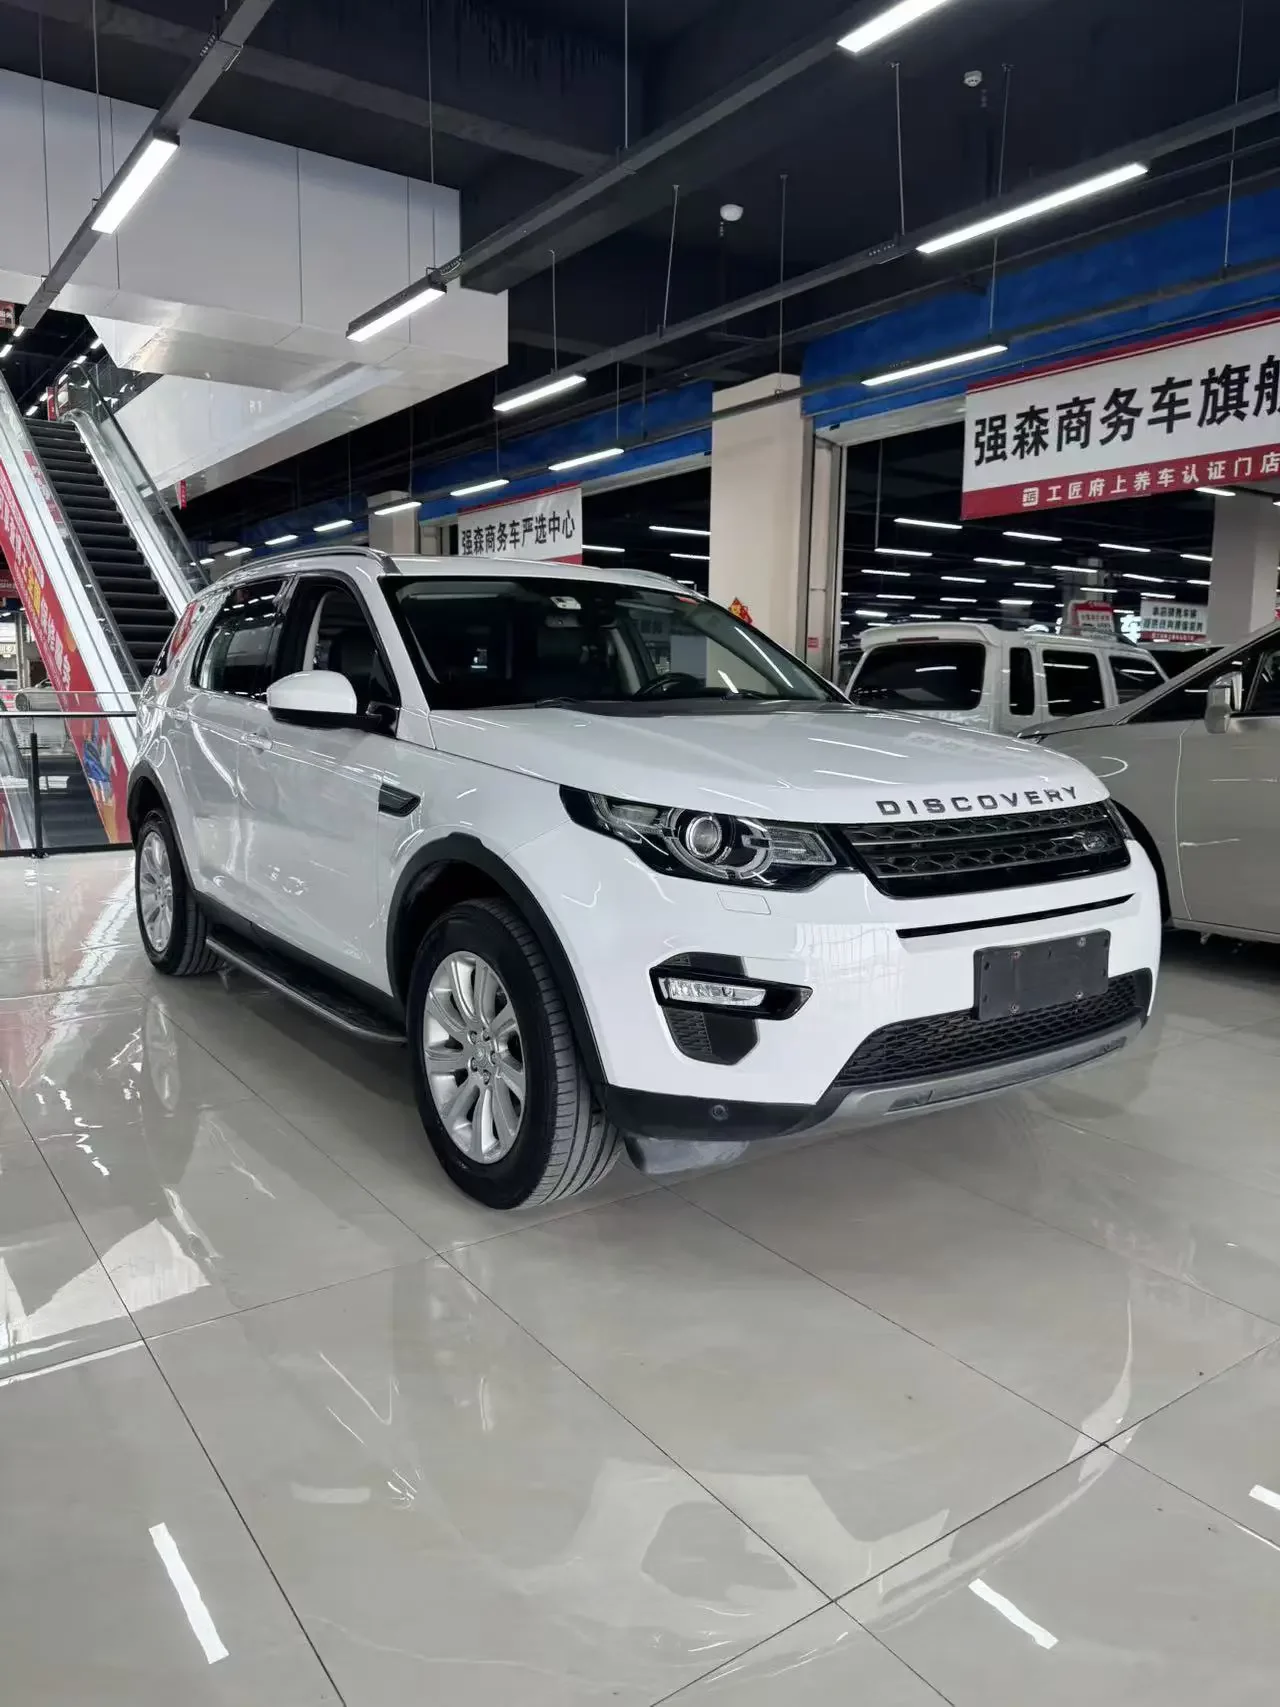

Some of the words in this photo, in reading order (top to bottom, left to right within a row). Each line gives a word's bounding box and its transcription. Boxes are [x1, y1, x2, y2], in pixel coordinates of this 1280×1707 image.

[461, 509, 576, 556] 强森商务车严选中心
[876, 786, 1078, 816] DISCOVERY
